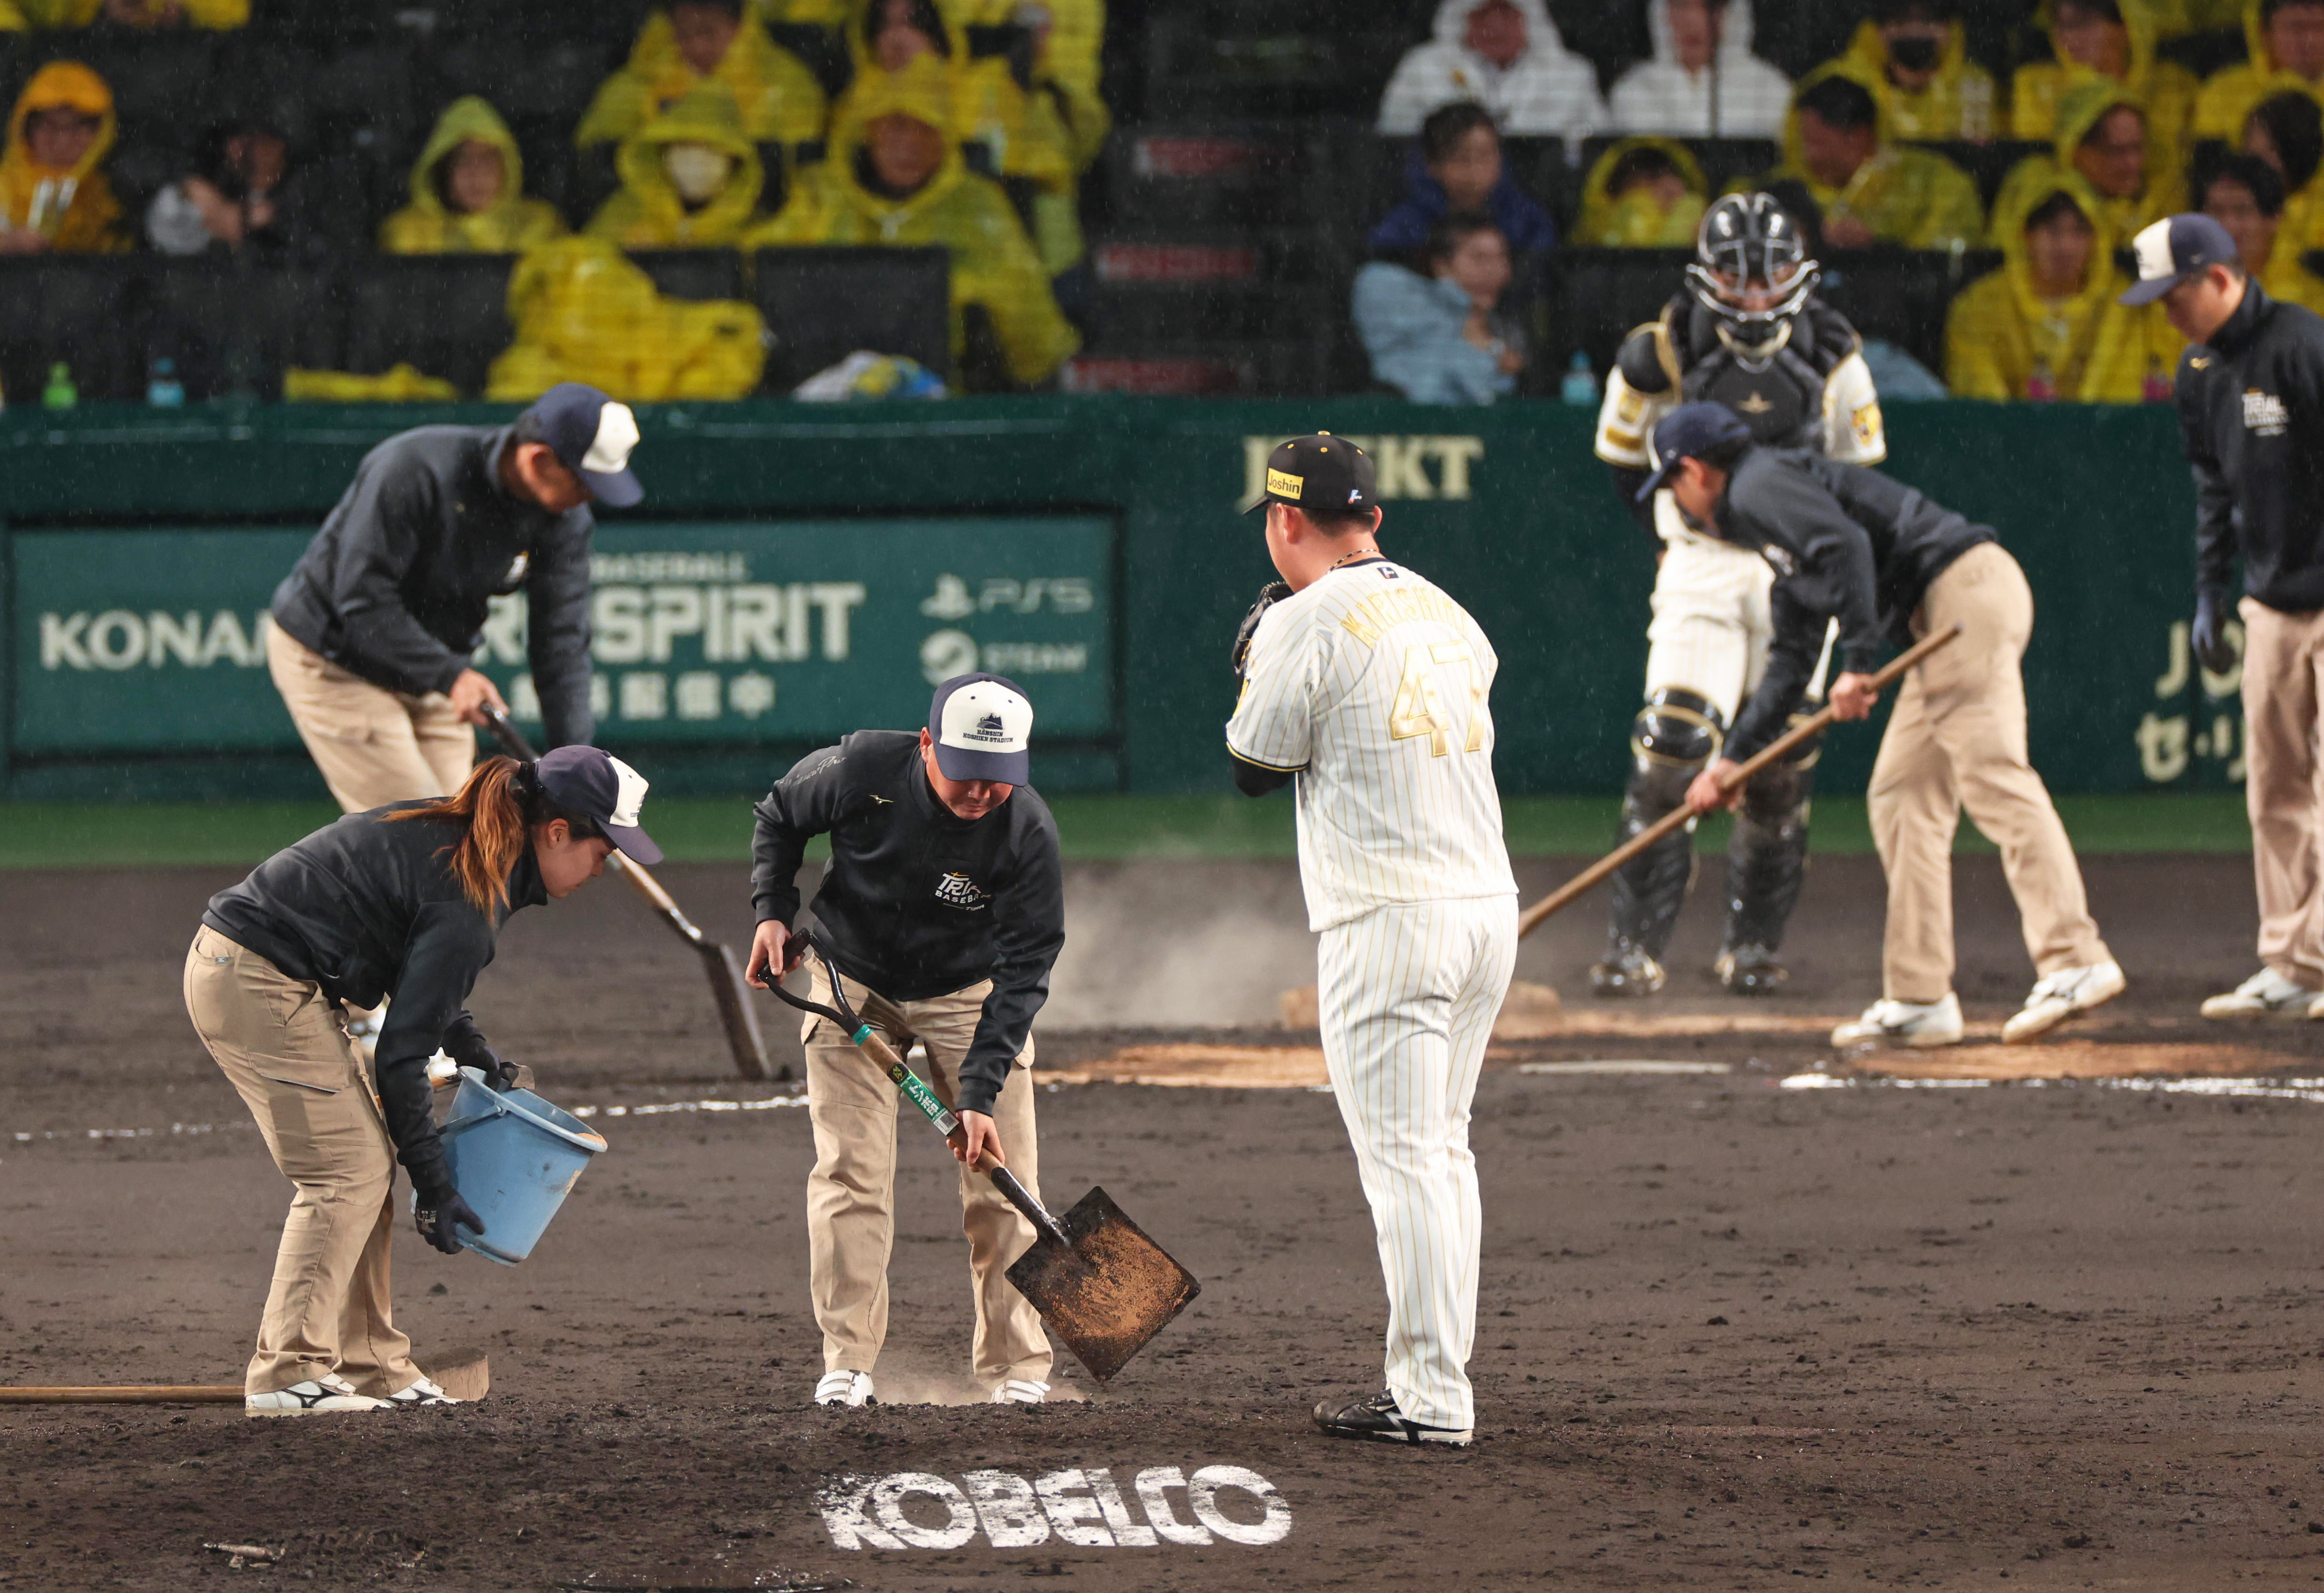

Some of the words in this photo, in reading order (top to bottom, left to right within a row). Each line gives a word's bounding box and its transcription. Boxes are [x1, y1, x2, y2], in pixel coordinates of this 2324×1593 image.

[1234, 435, 1486, 505] JKT
[1268, 474, 1300, 494] Joshin
[591, 582, 866, 662] SPIRIT
[978, 577, 1094, 614] PS5
[1390, 639, 1484, 757] 47
[963, 732, 988, 742] KOSHIEN
[977, 729, 1003, 737] HANSHIN
[818, 1464, 1292, 1550] KOBELCO
